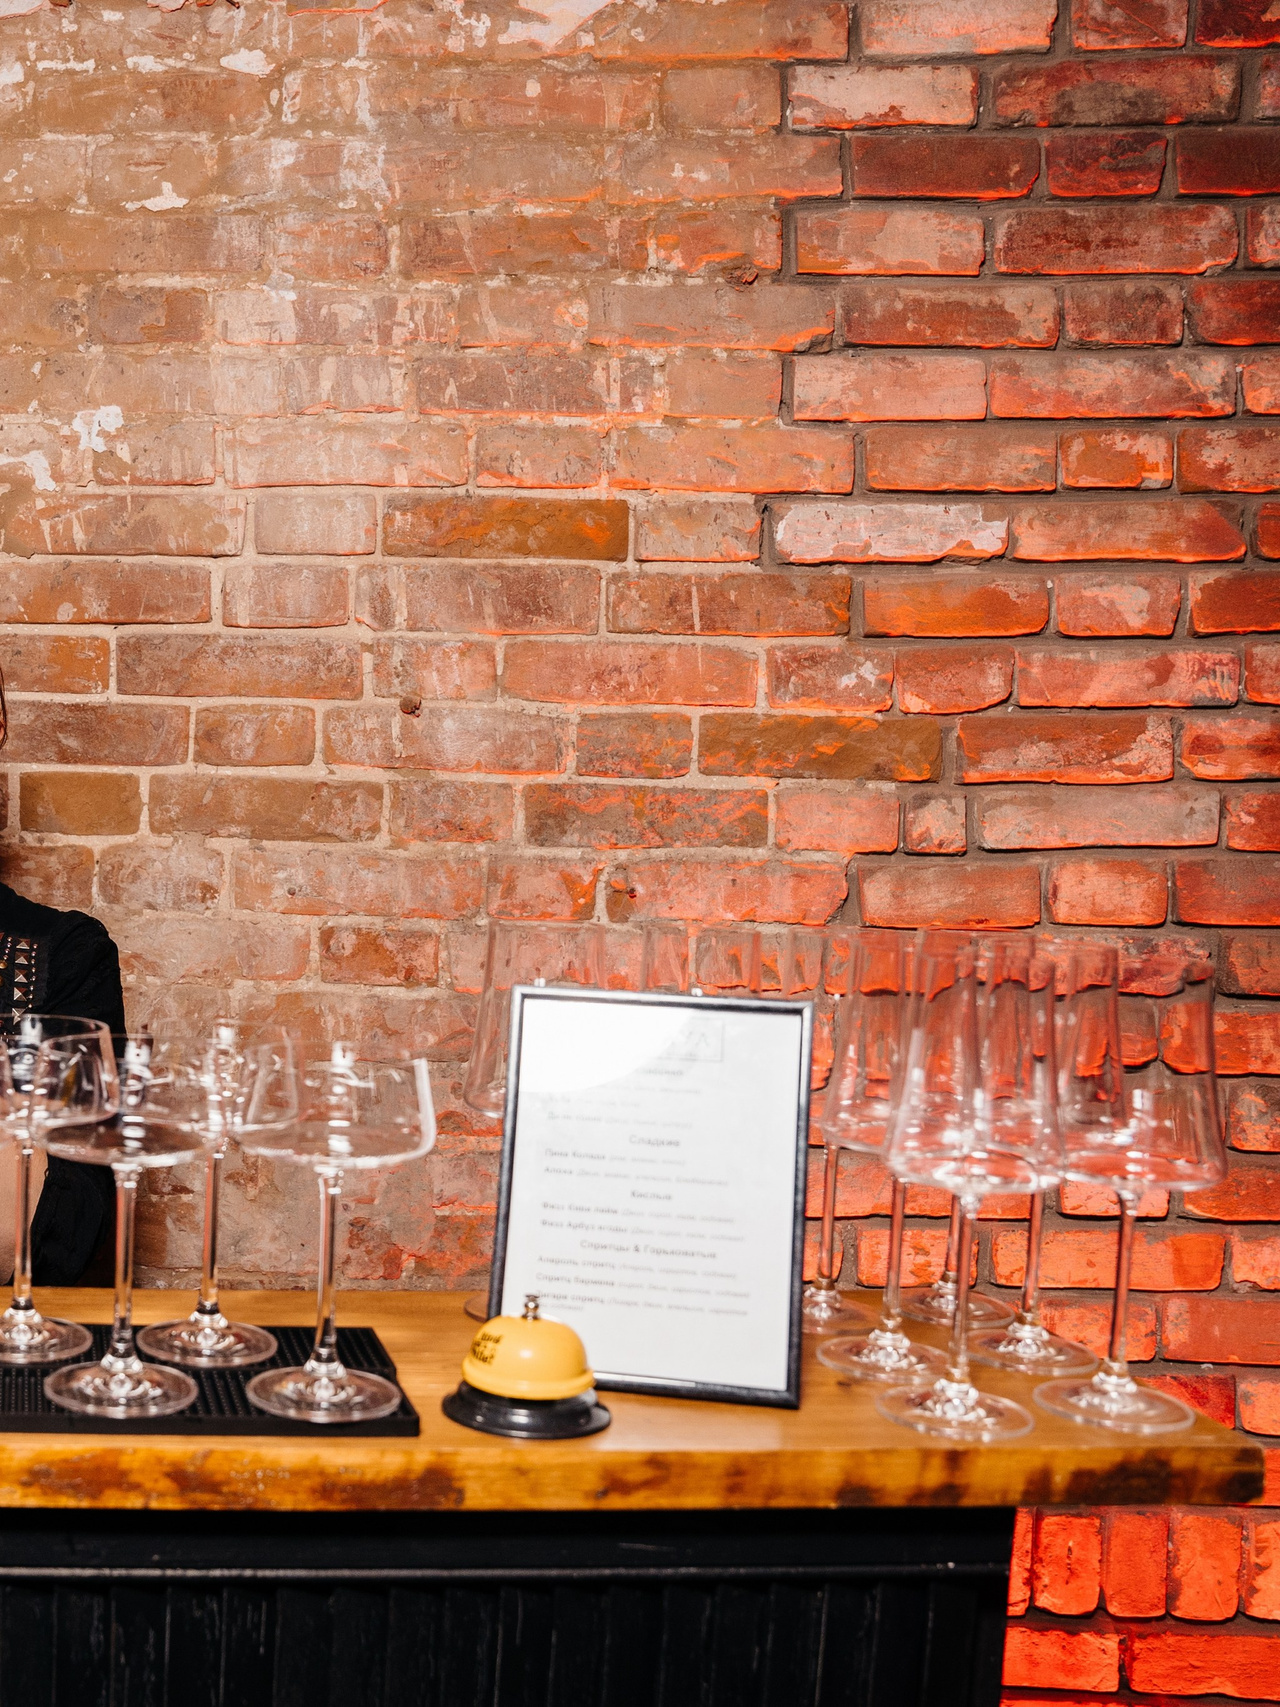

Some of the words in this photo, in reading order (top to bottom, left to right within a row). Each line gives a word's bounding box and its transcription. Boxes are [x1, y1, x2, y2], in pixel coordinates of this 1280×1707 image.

[628, 1134, 681, 1148] Сладкие
[630, 1190, 673, 1201] Кислые
[580, 1239, 630, 1253] Спритцы
[633, 1244, 641, 1254] &
[644, 1244, 717, 1259] Горьковатые
